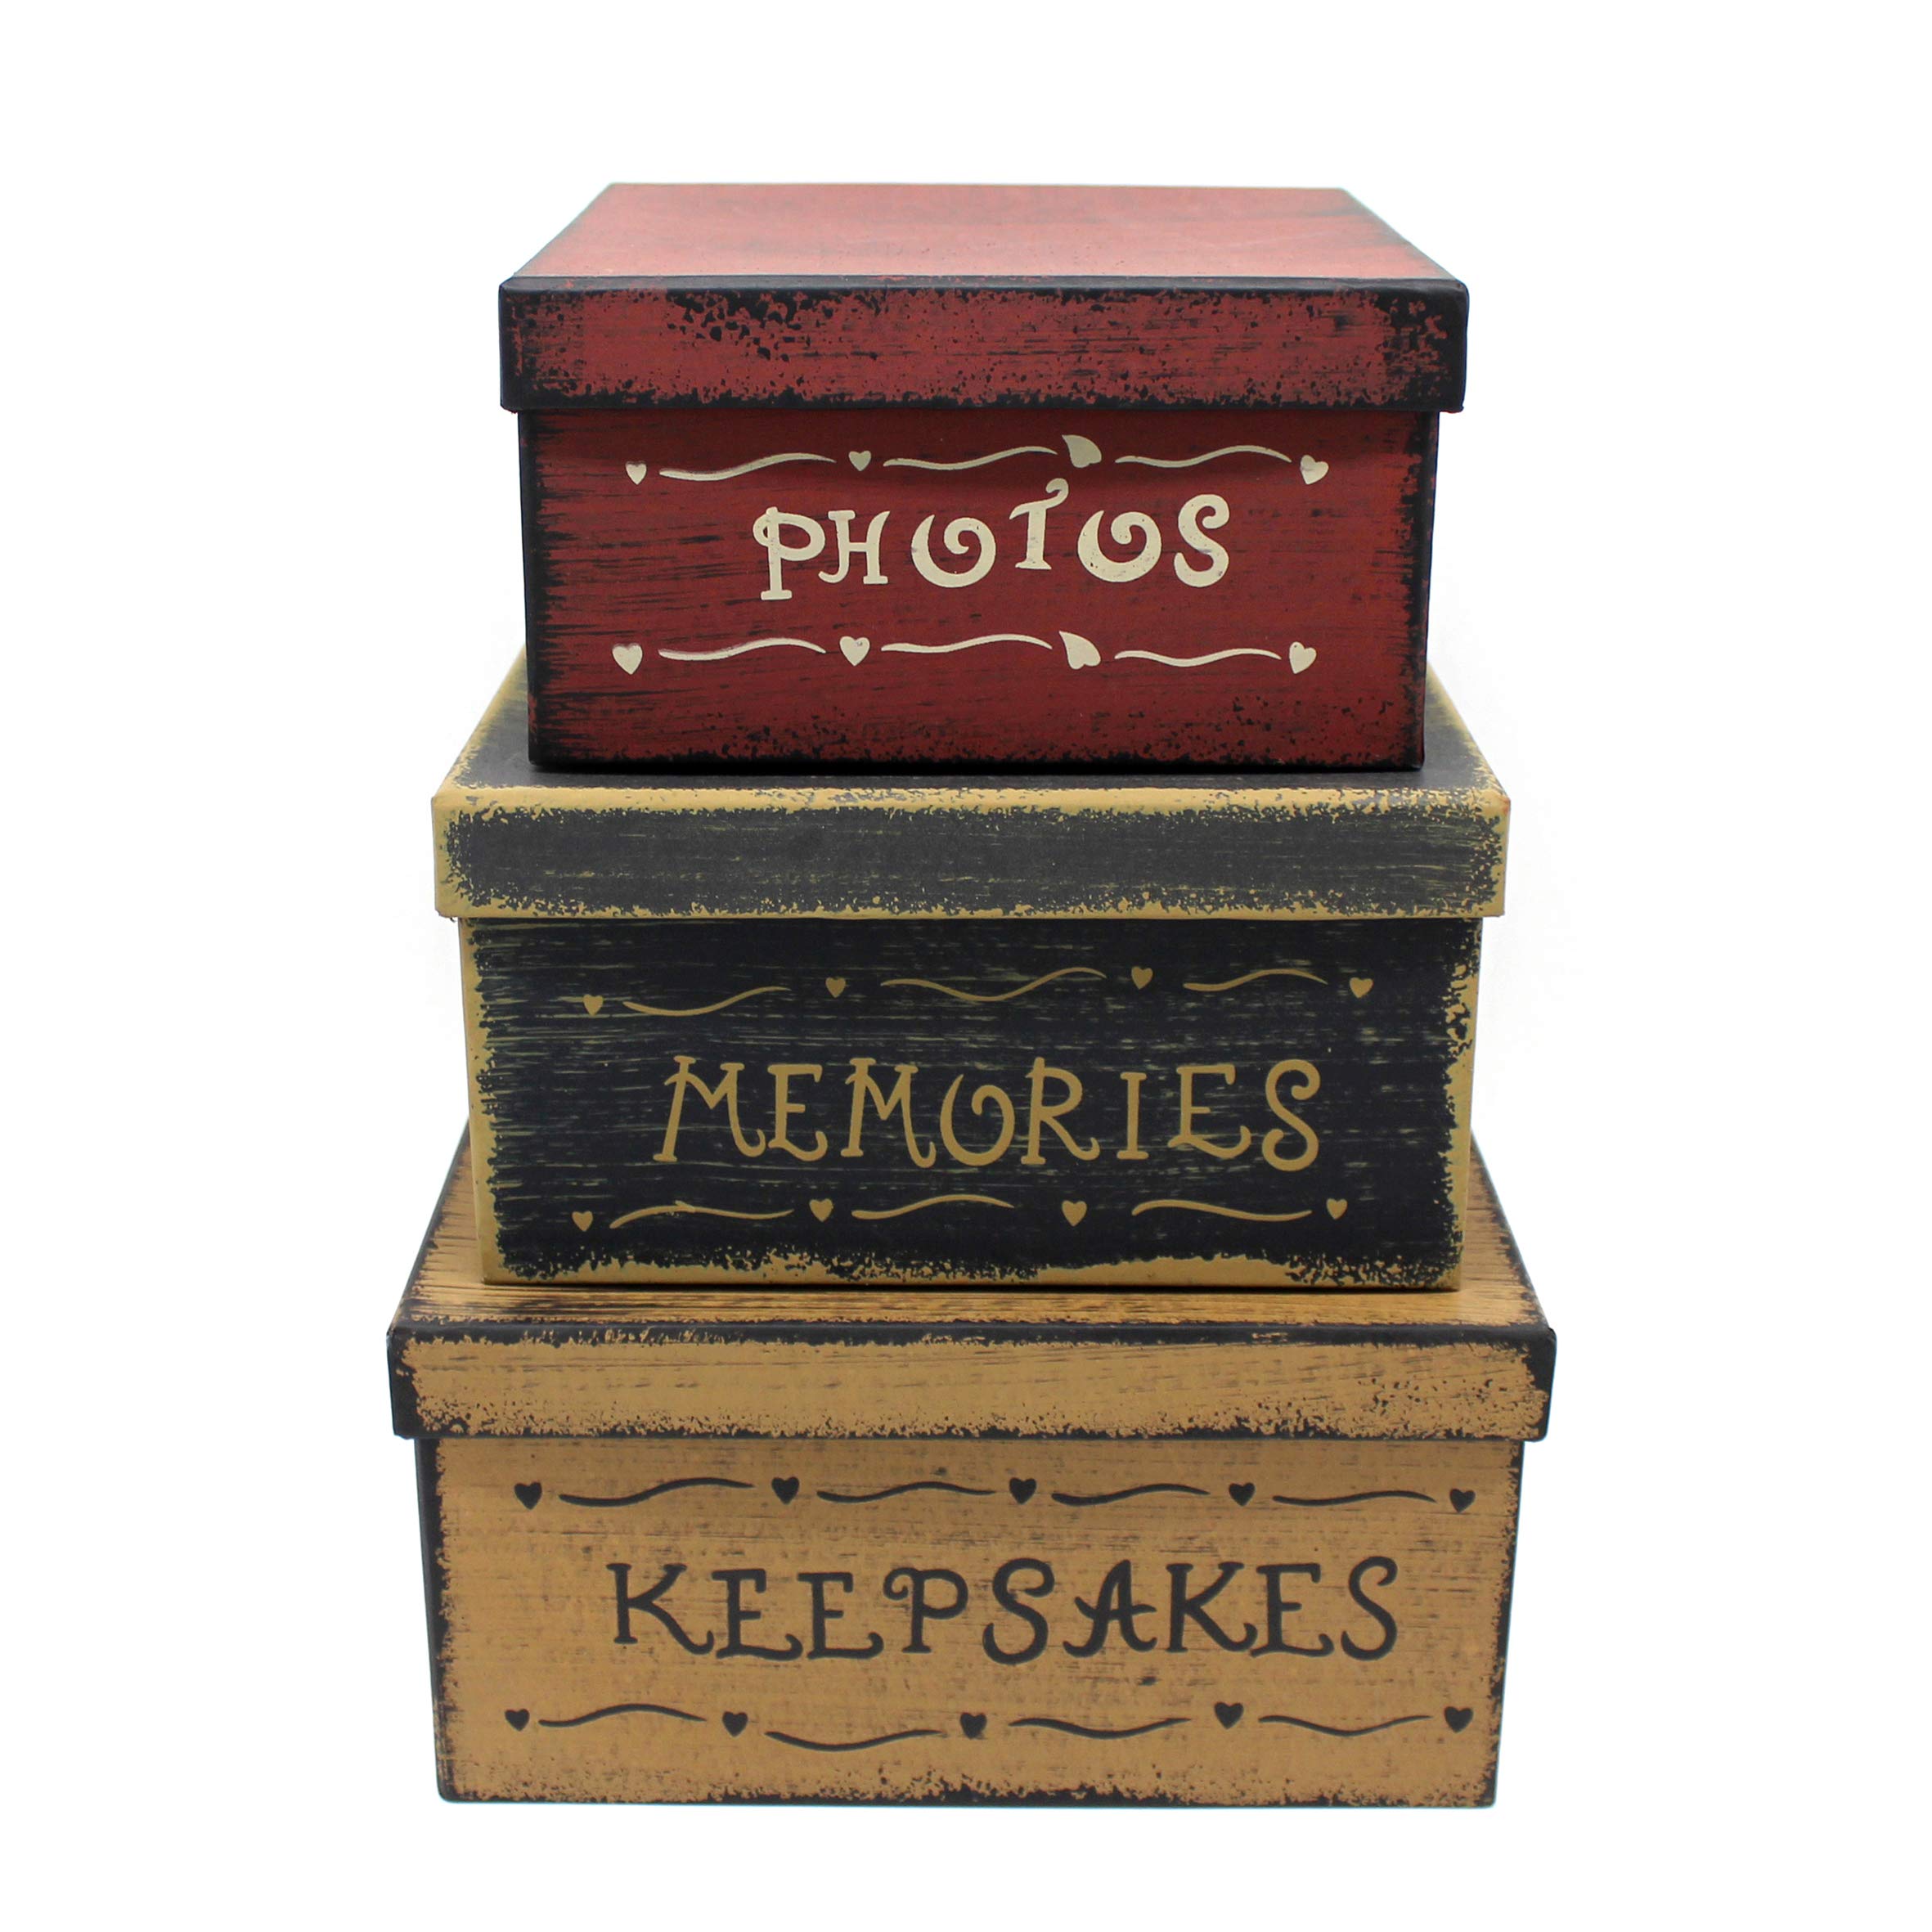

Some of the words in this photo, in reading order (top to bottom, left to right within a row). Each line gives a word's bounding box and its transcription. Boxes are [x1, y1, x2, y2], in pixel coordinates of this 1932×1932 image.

[753, 478, 1230, 600] PHOTOS
[654, 1055, 1321, 1172] MEMORIES
[606, 1557, 1398, 1665] KEEPSAKES
